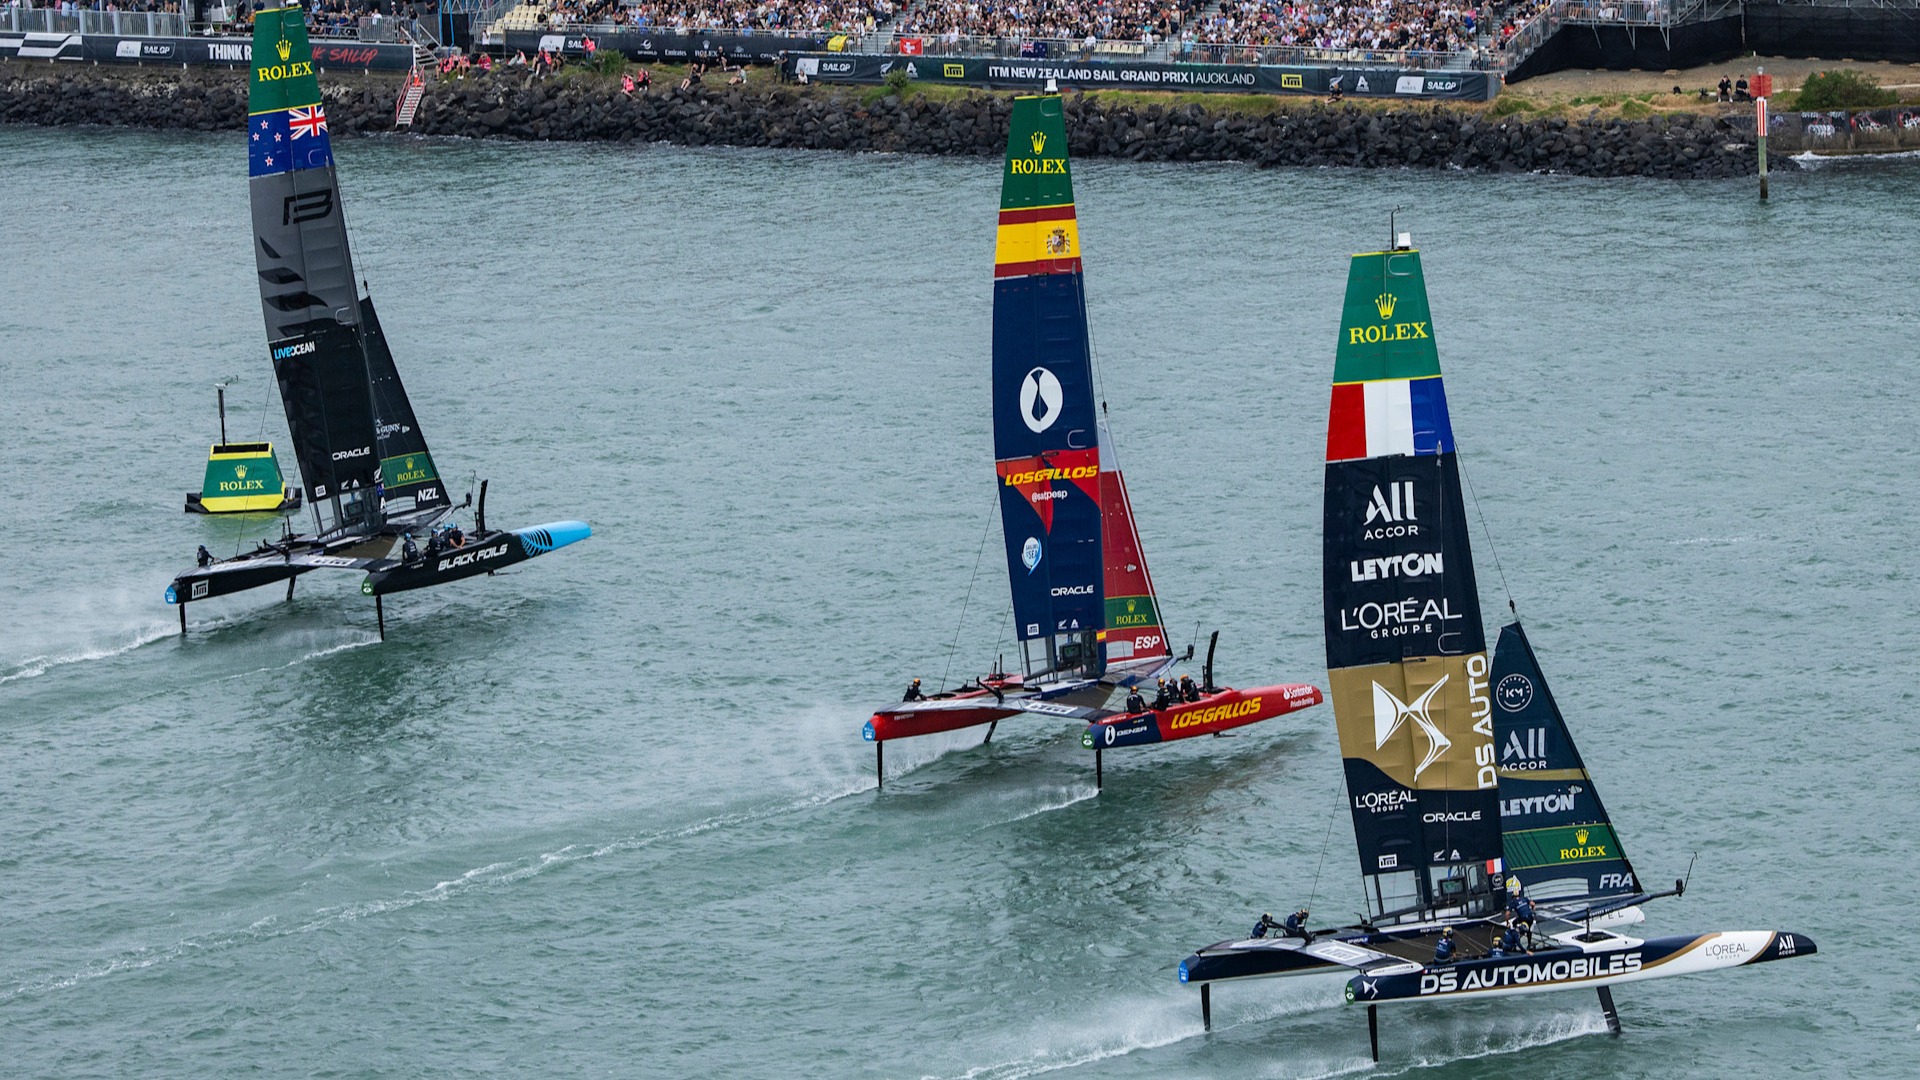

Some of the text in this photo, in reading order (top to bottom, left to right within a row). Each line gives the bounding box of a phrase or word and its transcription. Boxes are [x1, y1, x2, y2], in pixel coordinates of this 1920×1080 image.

[207, 43, 242, 60] THINK
[328, 47, 378, 66] SAILGP
[257, 61, 313, 82] ROLEX
[989, 66, 1255, 85] ITM NEW ZEALAND SAIL GRAND PRIX AUCKLAND
[1011, 159, 1066, 174] ROLEX
[1349, 322, 1428, 344] ROLEX
[332, 447, 370, 461] ORACLE
[397, 469, 426, 482] ROLEX
[219, 480, 264, 491] ROLEX
[417, 487, 440, 502] NZL
[1364, 525, 1419, 541] ACCOR
[438, 544, 508, 571] BLACK FOILS
[1351, 552, 1444, 582] LEYTON
[1051, 585, 1094, 596] ORACLE
[1116, 614, 1147, 625] ROLEX
[1341, 597, 1462, 631] L'ORÉAL
[1371, 624, 1432, 639] GROUPE
[1135, 636, 1160, 649] ESP
[1289, 685, 1313, 698] Santander
[1466, 654, 1498, 789] DS AUTO
[1501, 761, 1547, 772] ACCOR
[1355, 790, 1417, 808] L'ORÉAL
[1500, 795, 1574, 816] LEYTON
[1370, 804, 1404, 813] GROUPE
[1423, 810, 1481, 823] ORACLE
[1560, 846, 1606, 859] ROLEX
[1599, 872, 1633, 889] FRA
[1706, 943, 1750, 956] L'ORÉAL
[1420, 953, 1642, 994] DS AUTOMOBILES
